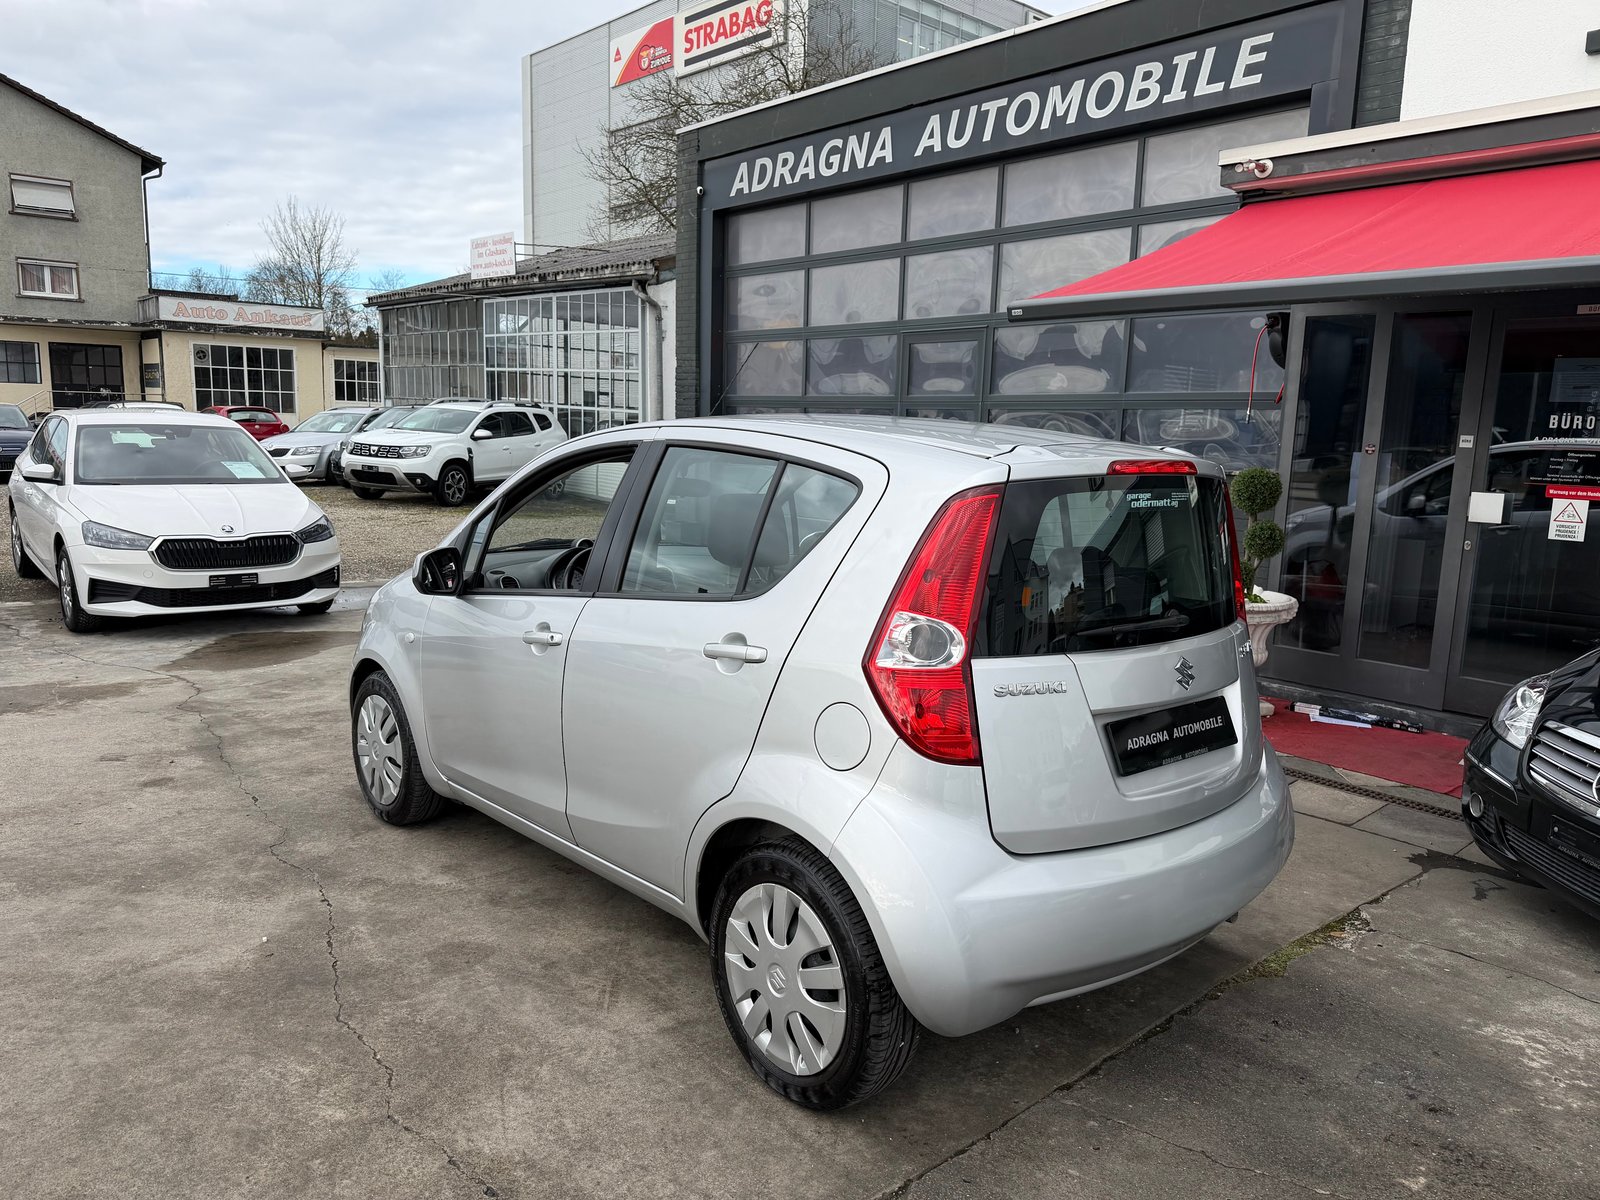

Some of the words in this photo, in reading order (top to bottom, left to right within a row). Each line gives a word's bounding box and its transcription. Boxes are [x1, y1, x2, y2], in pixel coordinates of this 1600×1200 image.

[683, 0, 773, 54] STRABAG
[729, 126, 893, 197] ADRAGNA
[914, 32, 1274, 157] AUTOMOBILE
[173, 301, 229, 321] Auto
[233, 307, 313, 327] Ankauf
[1548, 412, 1596, 430] BÜRO
[1126, 492, 1152, 502] garage
[993, 680, 1067, 698] SUZUKI
[1127, 730, 1170, 751] ADRAGNA
[1173, 715, 1223, 739] AUTOMOBILE
